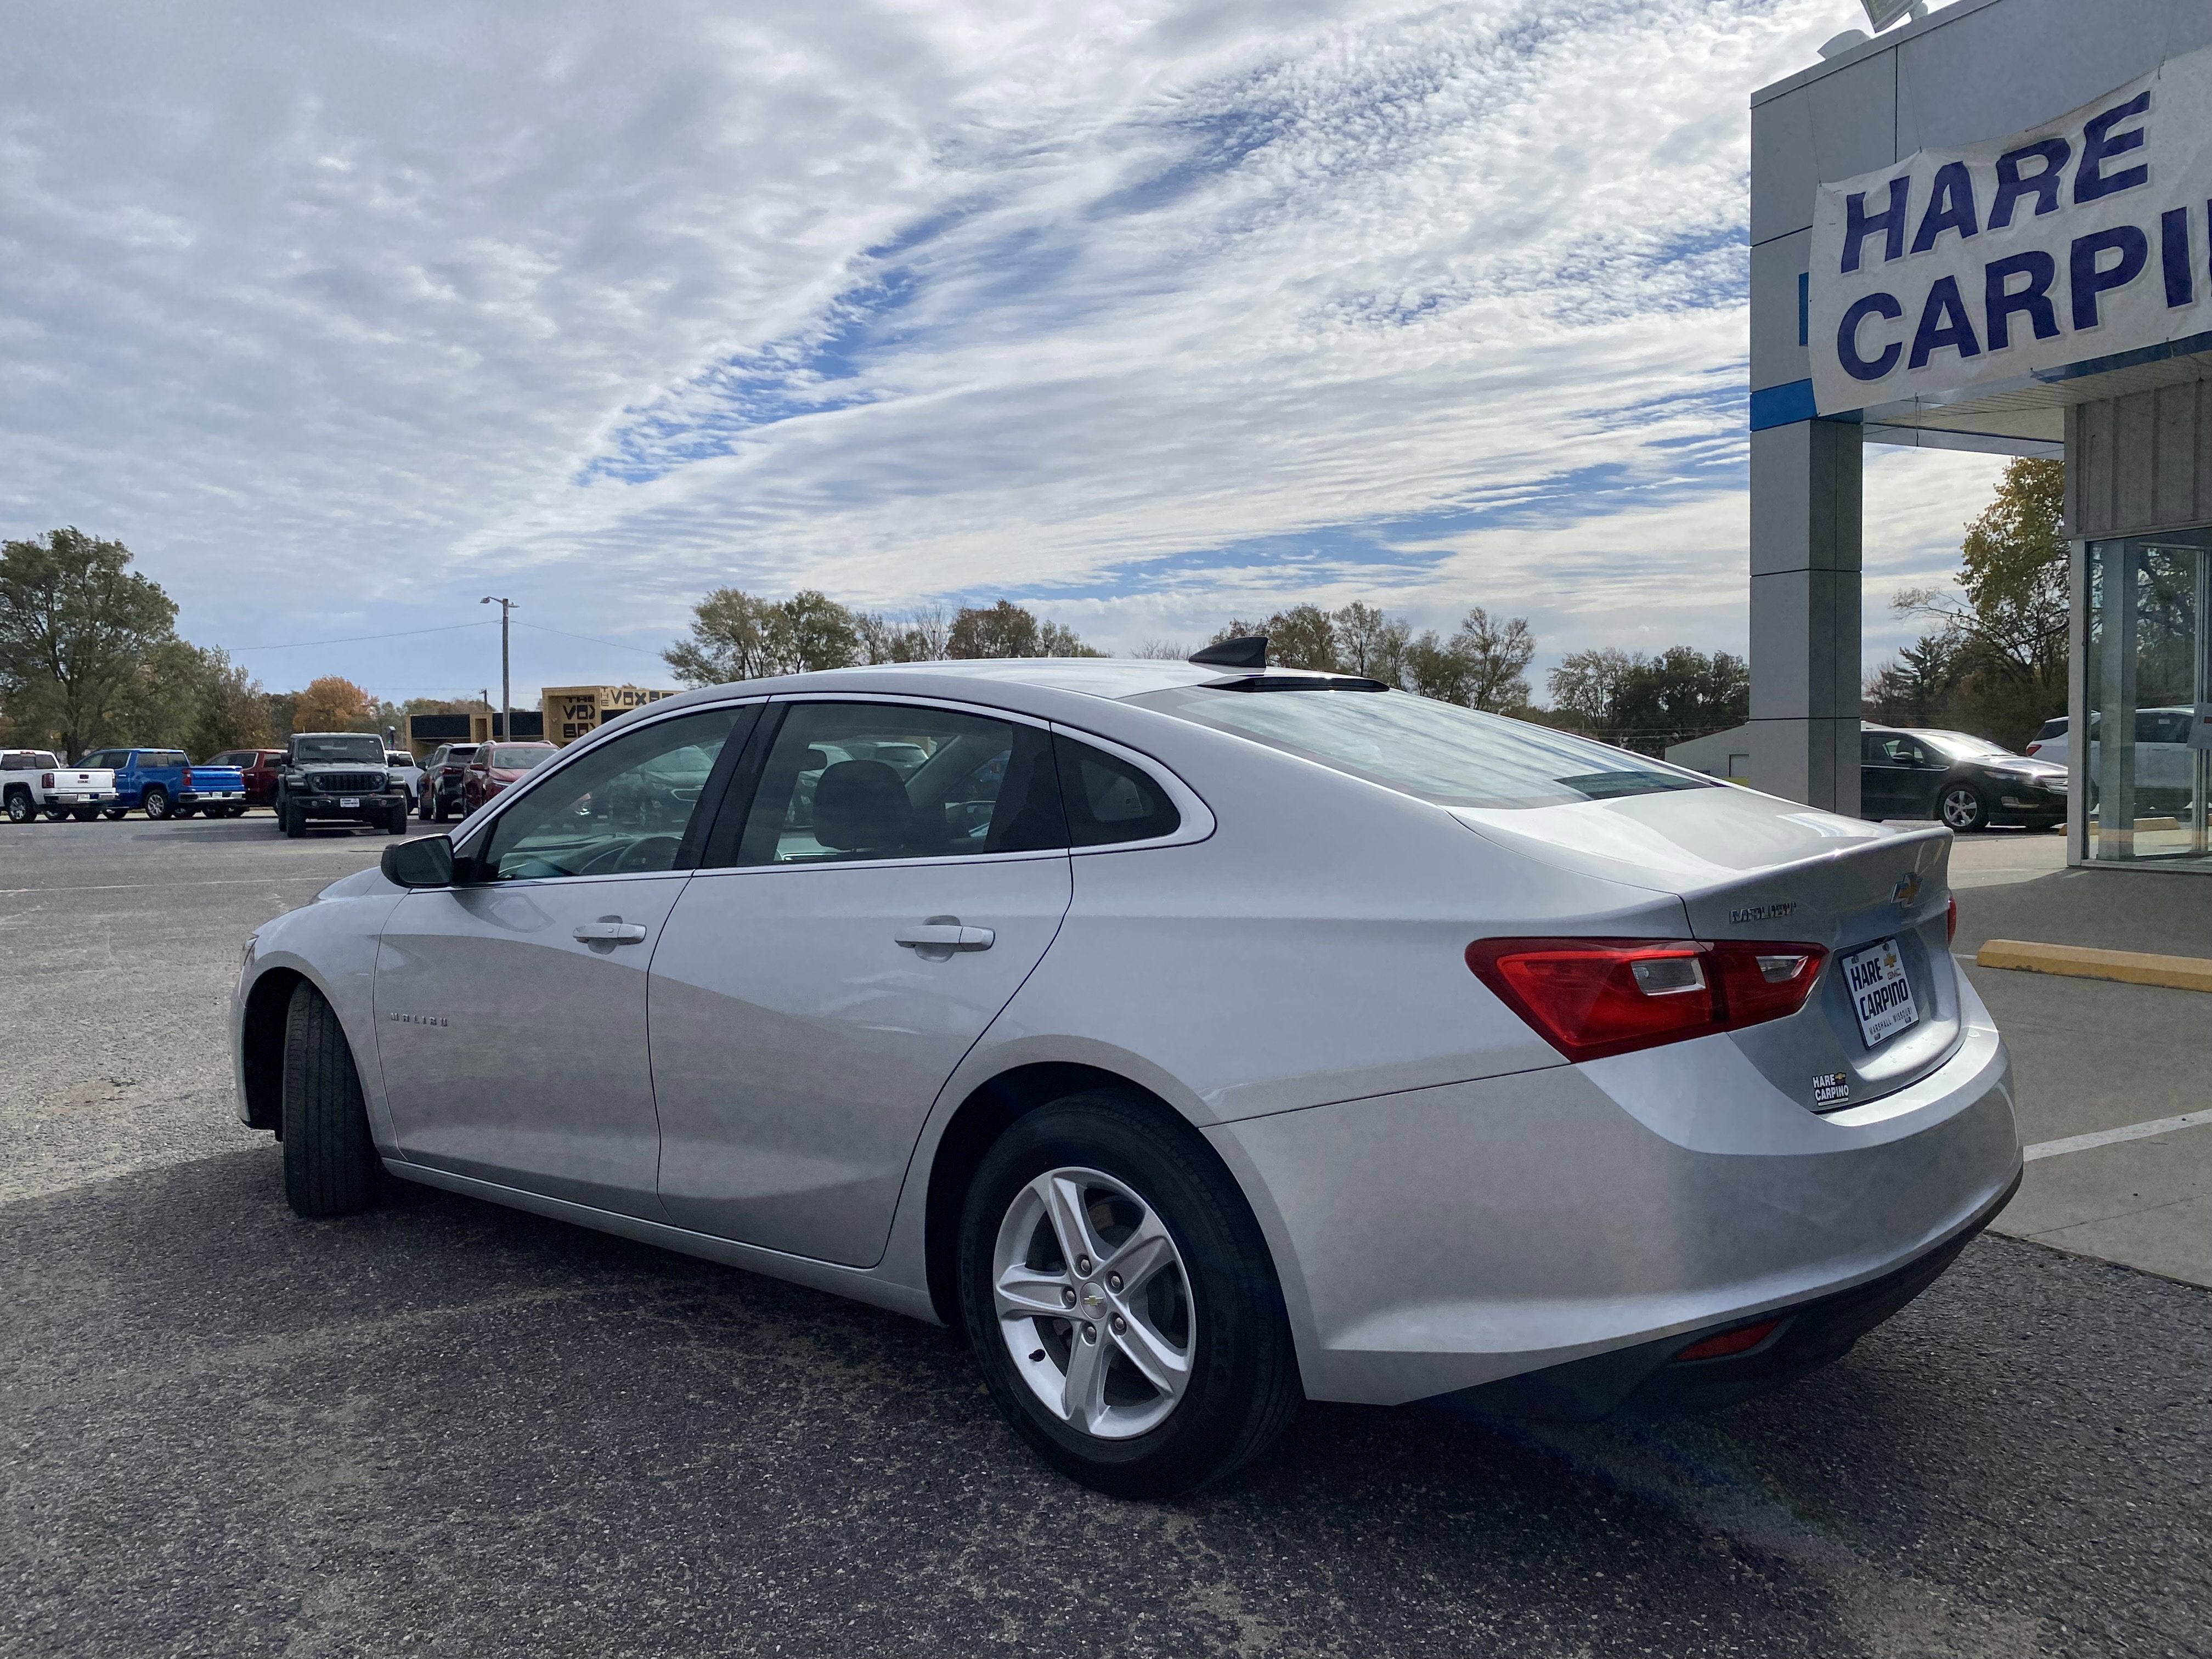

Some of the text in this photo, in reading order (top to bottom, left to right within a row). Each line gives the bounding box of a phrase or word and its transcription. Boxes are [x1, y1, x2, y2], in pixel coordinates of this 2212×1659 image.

[1841, 90, 2151, 274] HARE
[1837, 199, 2212, 381] CARPI
[563, 722, 596, 738] BO
[1850, 957, 1883, 992] HARE
[1887, 968, 1901, 980] GMC
[1860, 978, 1909, 1022] CARPINO
[390, 1012, 448, 1027] MALIBU
[1892, 1006, 1913, 1023] MISSOURI
[1812, 1074, 1836, 1088] HARE
[1815, 1084, 1849, 1101] CARPINO
